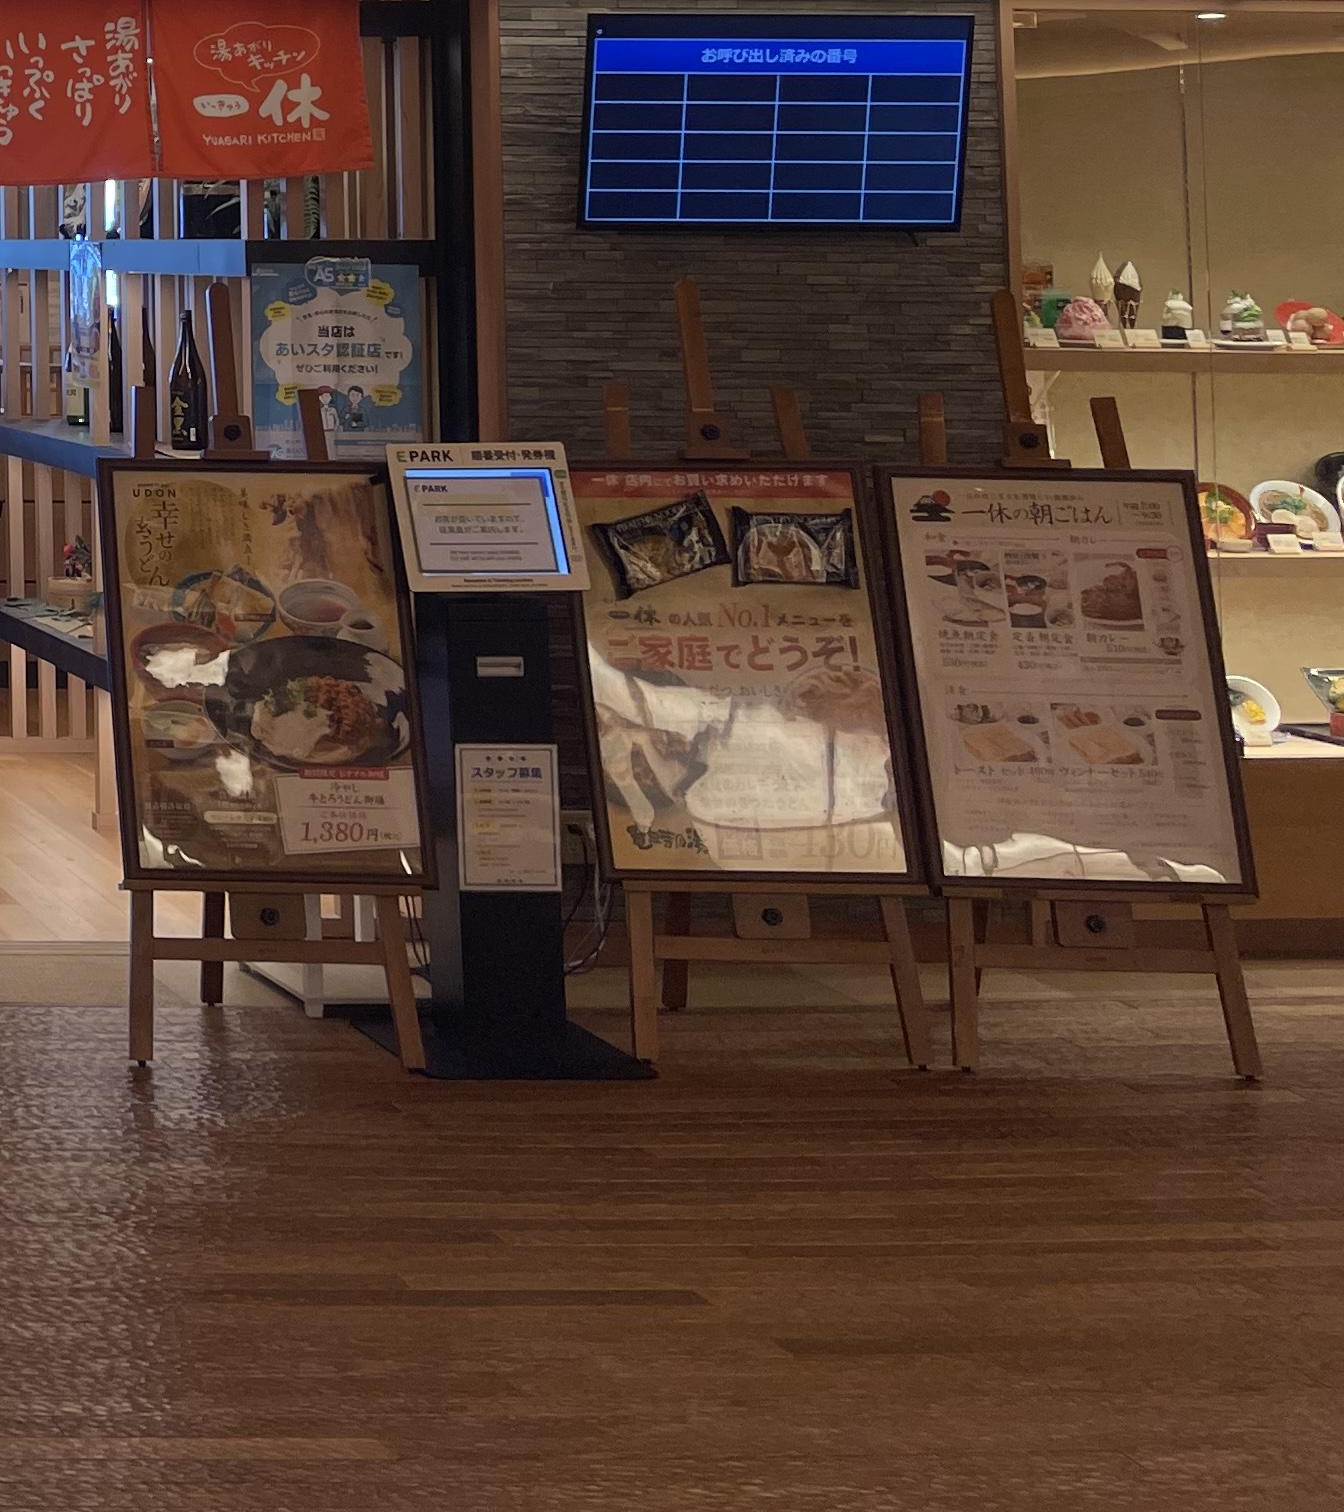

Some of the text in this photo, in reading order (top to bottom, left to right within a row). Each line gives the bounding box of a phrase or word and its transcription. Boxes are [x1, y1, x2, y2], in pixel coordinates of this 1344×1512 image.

[210, 39, 272, 63] 湯あがり
[248, 50, 306, 70] キッチン
[700, 48, 858, 65] お呼び出し済みの番号
[19, 33, 53, 122] いっぷく
[104, 17, 141, 116] 湯あがり
[61, 35, 105, 128] さっぱり
[203, 131, 311, 146] YUAGARI KITCHEN
[318, 326, 355, 338] 当店は
[133, 489, 176, 498] UDON
[961, 501, 1113, 526] 一休の朝ごはん
[152, 500, 180, 562] 幸せの
